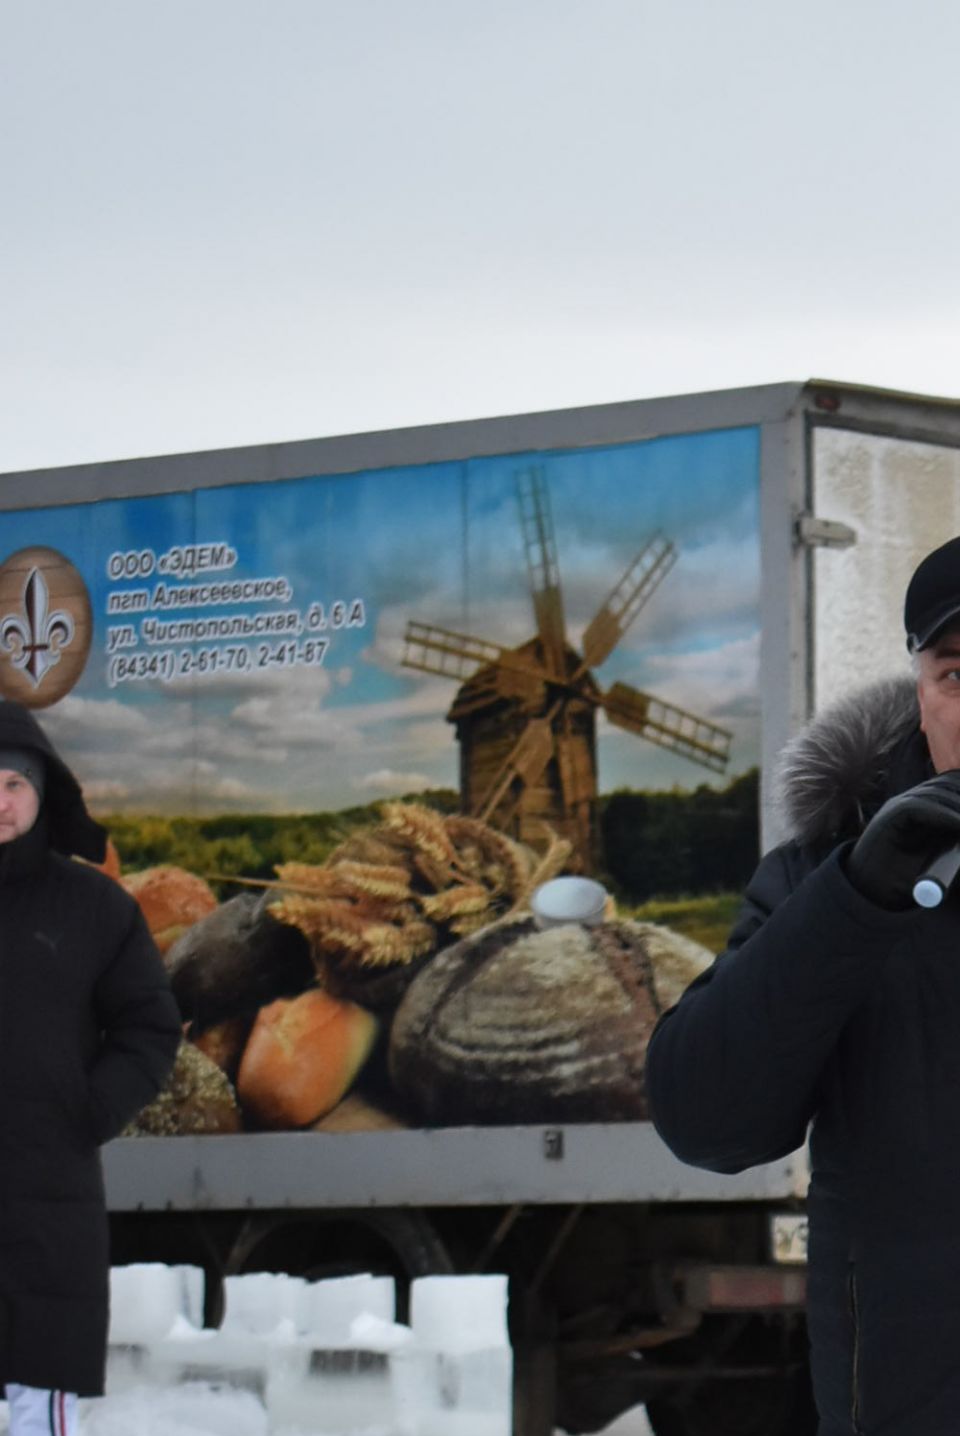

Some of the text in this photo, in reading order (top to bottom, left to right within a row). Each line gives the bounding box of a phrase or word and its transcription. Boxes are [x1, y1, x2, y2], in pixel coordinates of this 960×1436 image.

[109, 546, 237, 578] ООО «ЭДЕМ»
[108, 579, 292, 613] пгт Алексеевское,
[108, 603, 364, 650] ул. Чистопольская, д. 6 А
[110, 641, 328, 684] (84341) 2-61-70, 2-41-87
